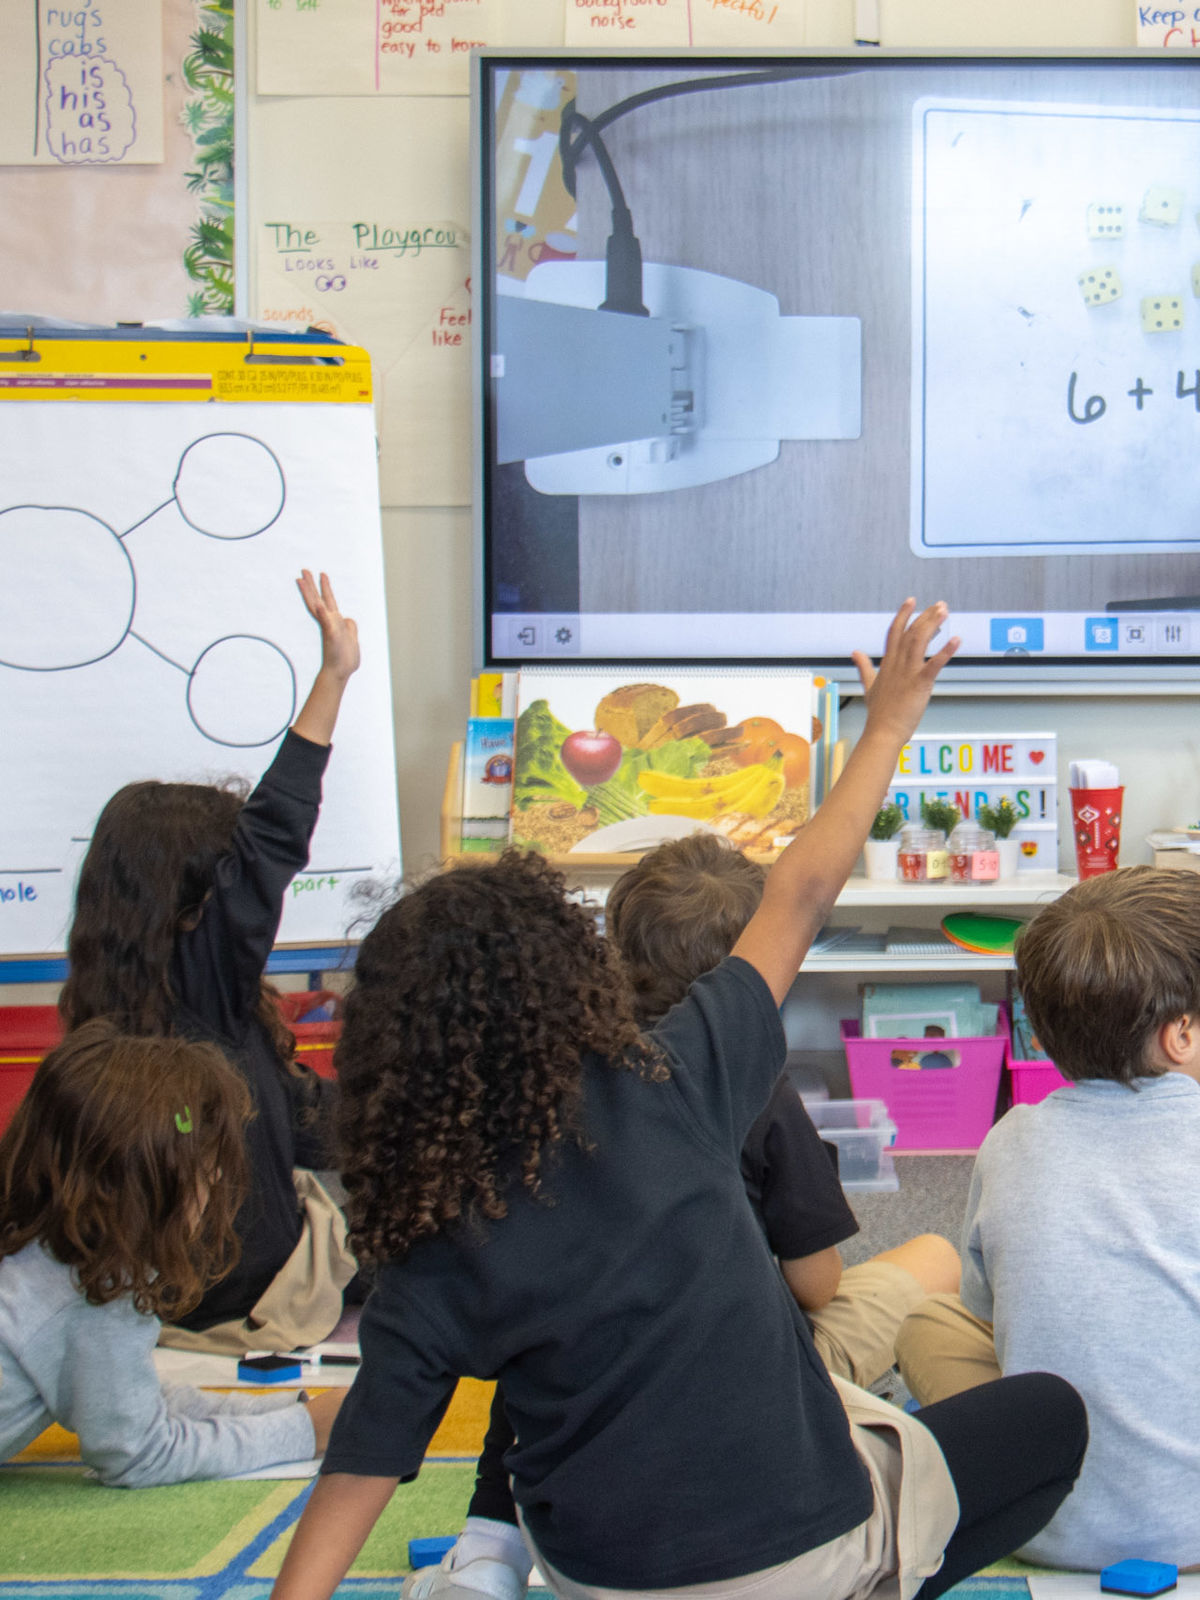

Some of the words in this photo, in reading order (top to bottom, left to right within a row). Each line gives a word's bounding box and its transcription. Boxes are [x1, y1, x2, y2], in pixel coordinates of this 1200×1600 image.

[47, 9, 103, 38] rugs
[382, 16, 423, 39] good
[590, 15, 636, 29] noise
[1139, 7, 1185, 27] Keep
[49, 31, 107, 56] cabs
[381, 40, 415, 58] easy
[426, 38, 441, 53] to
[81, 60, 104, 88] is
[60, 85, 106, 110] his
[79, 112, 111, 132] as
[62, 132, 110, 155] has
[265, 223, 320, 249] The
[352, 222, 458, 257] Playgrou
[285, 258, 334, 272] Looks
[350, 256, 380, 270] Like
[263, 307, 314, 322] sounds
[432, 331, 462, 346] like
[1068, 372, 1106, 424] 6
[1128, 377, 1153, 410] +
[898, 744, 1013, 774] ELCOME
[895, 789, 1047, 820] RINDS!
[0, 881, 38, 903] ole
[291, 876, 341, 898] part
